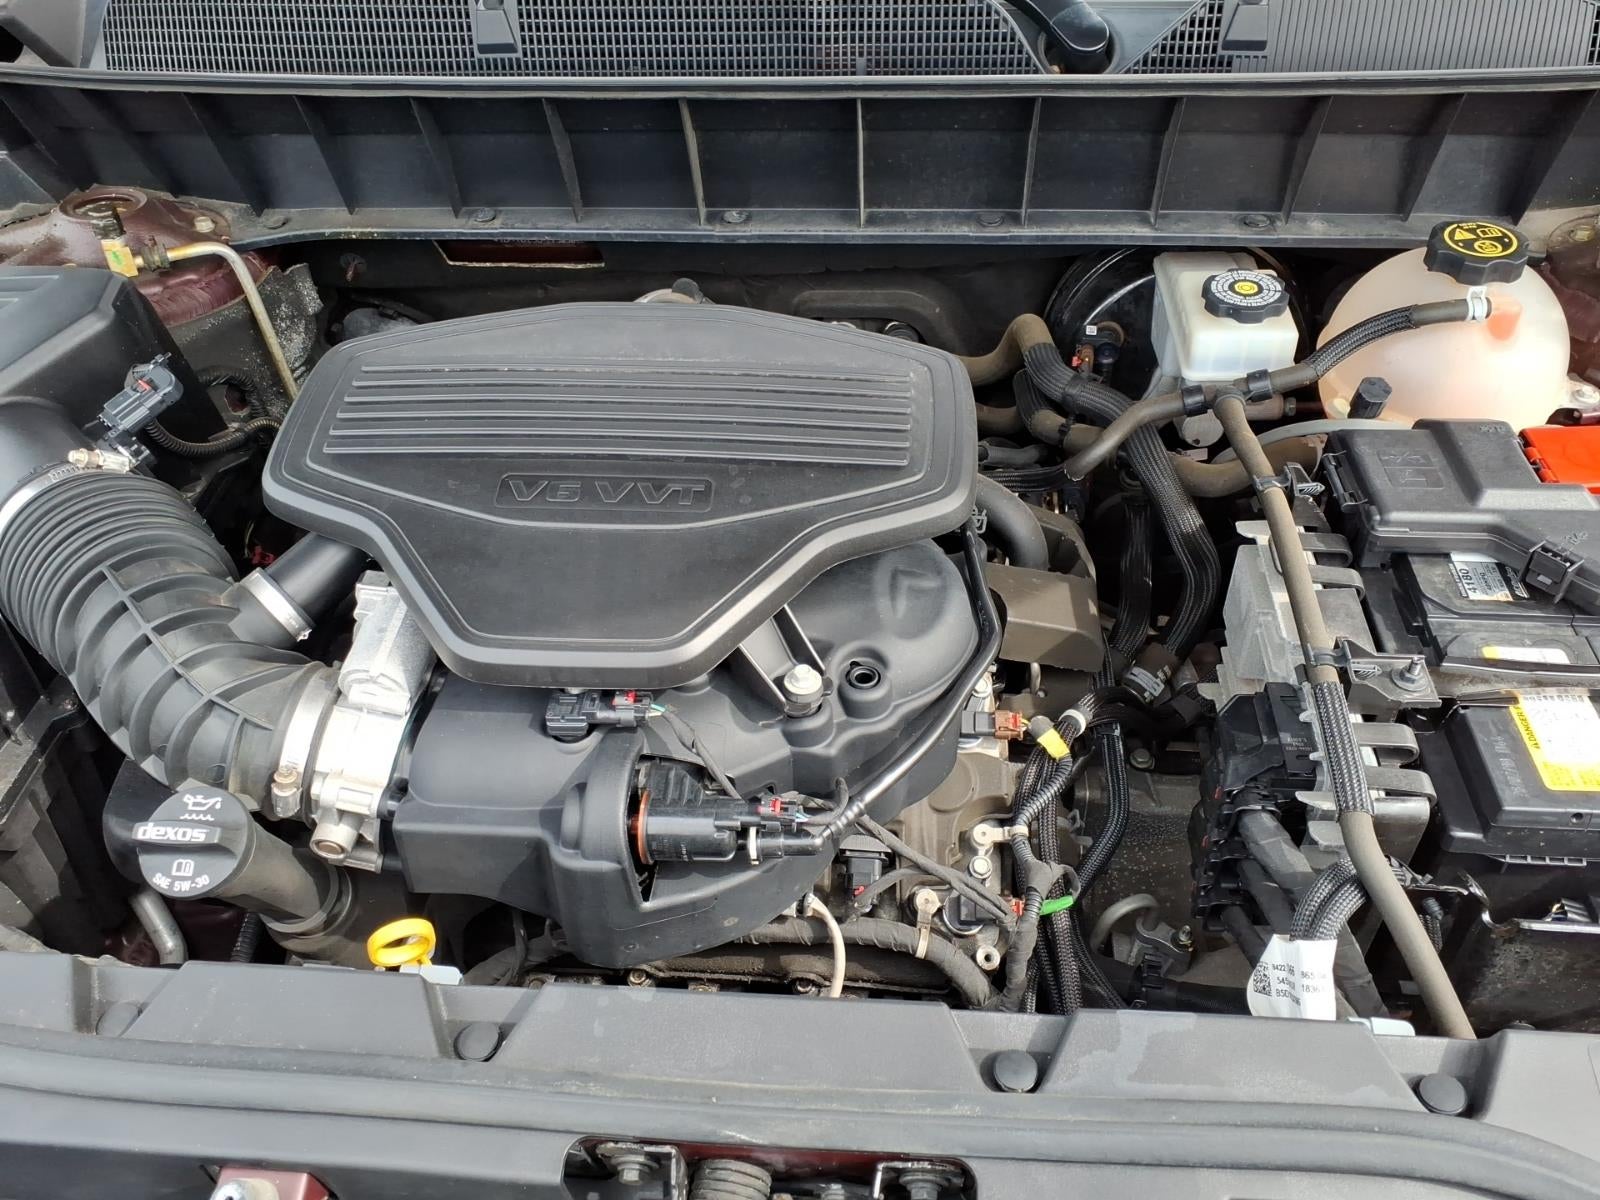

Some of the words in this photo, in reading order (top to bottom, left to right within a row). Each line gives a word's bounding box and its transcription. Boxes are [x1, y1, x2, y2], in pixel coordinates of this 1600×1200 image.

[507, 480, 581, 502] V6
[594, 481, 705, 505] VVT
[136, 822, 209, 842] dexos
[152, 873, 171, 889] SAE
[173, 874, 210, 892] 5W-30
